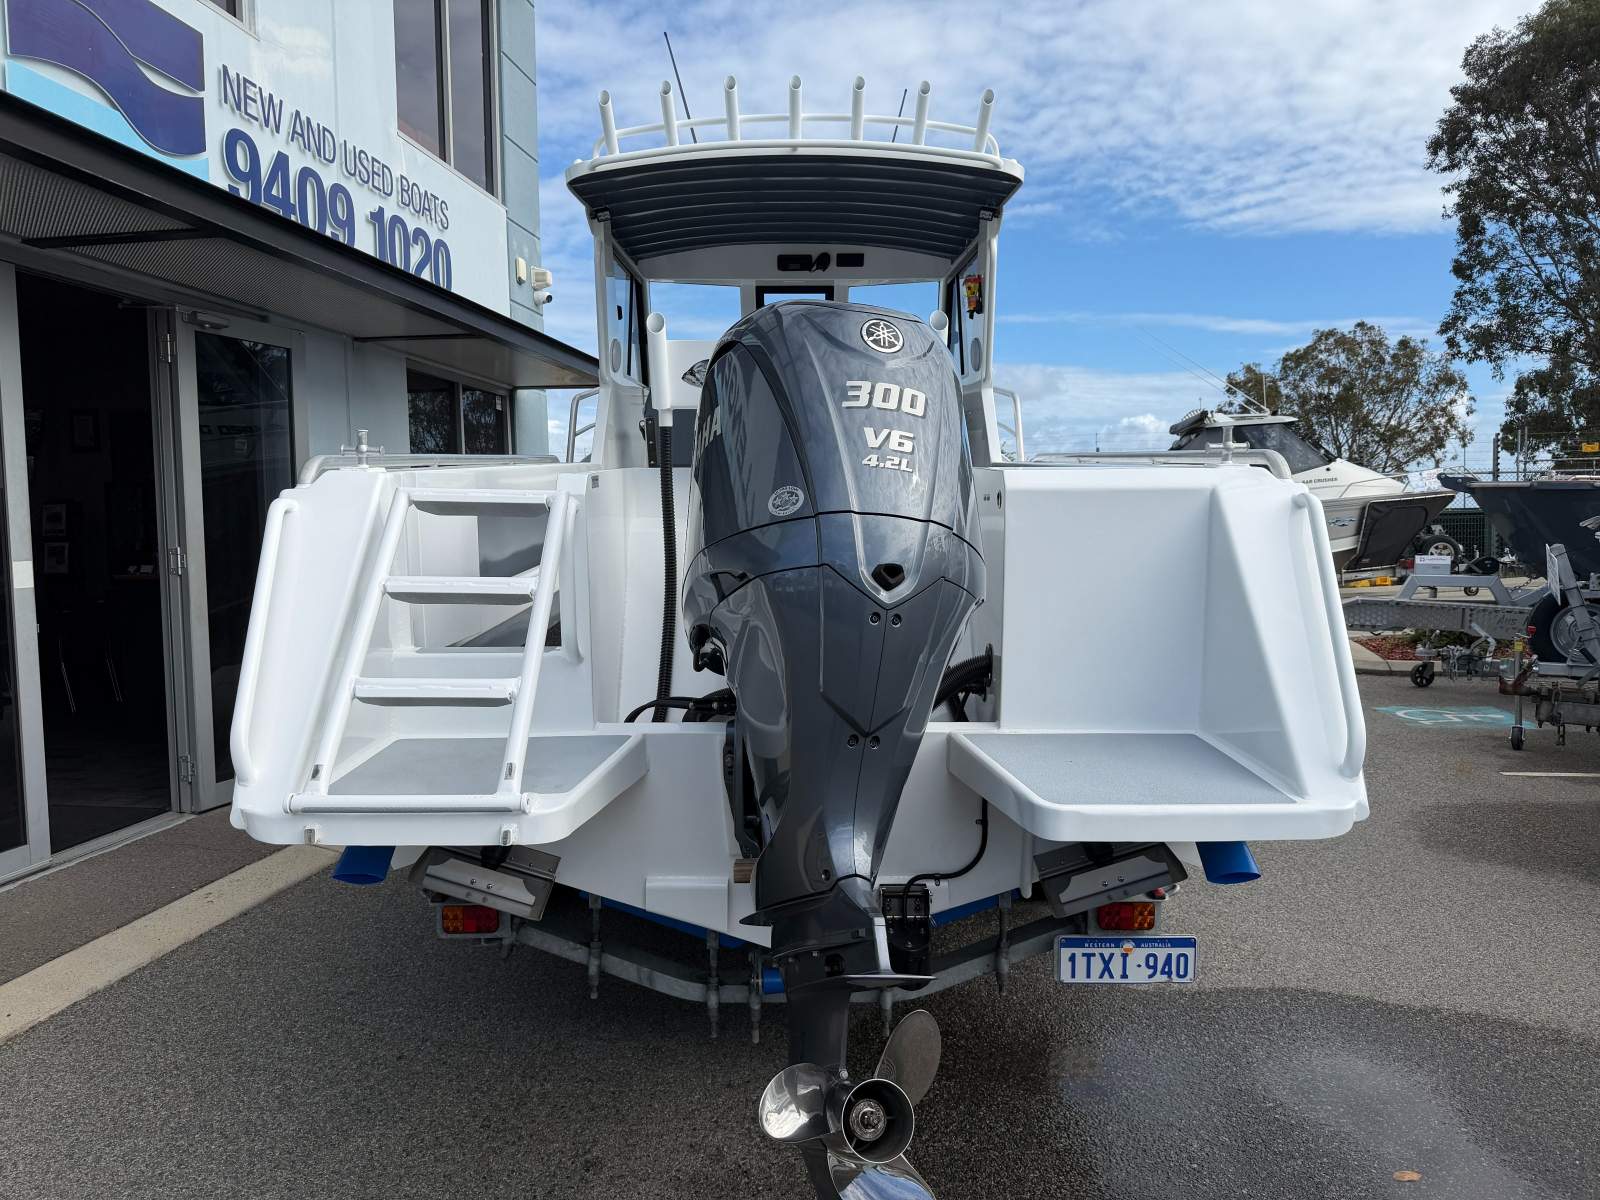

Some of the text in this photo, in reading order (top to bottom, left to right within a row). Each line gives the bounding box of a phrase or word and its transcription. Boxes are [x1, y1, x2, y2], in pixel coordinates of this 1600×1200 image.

[222, 63, 449, 230] NEW AND USED BOATS
[224, 128, 452, 292] 9409 1020
[842, 381, 926, 417] 300
[863, 427, 914, 453] V6
[862, 454, 913, 473] 4.2L
